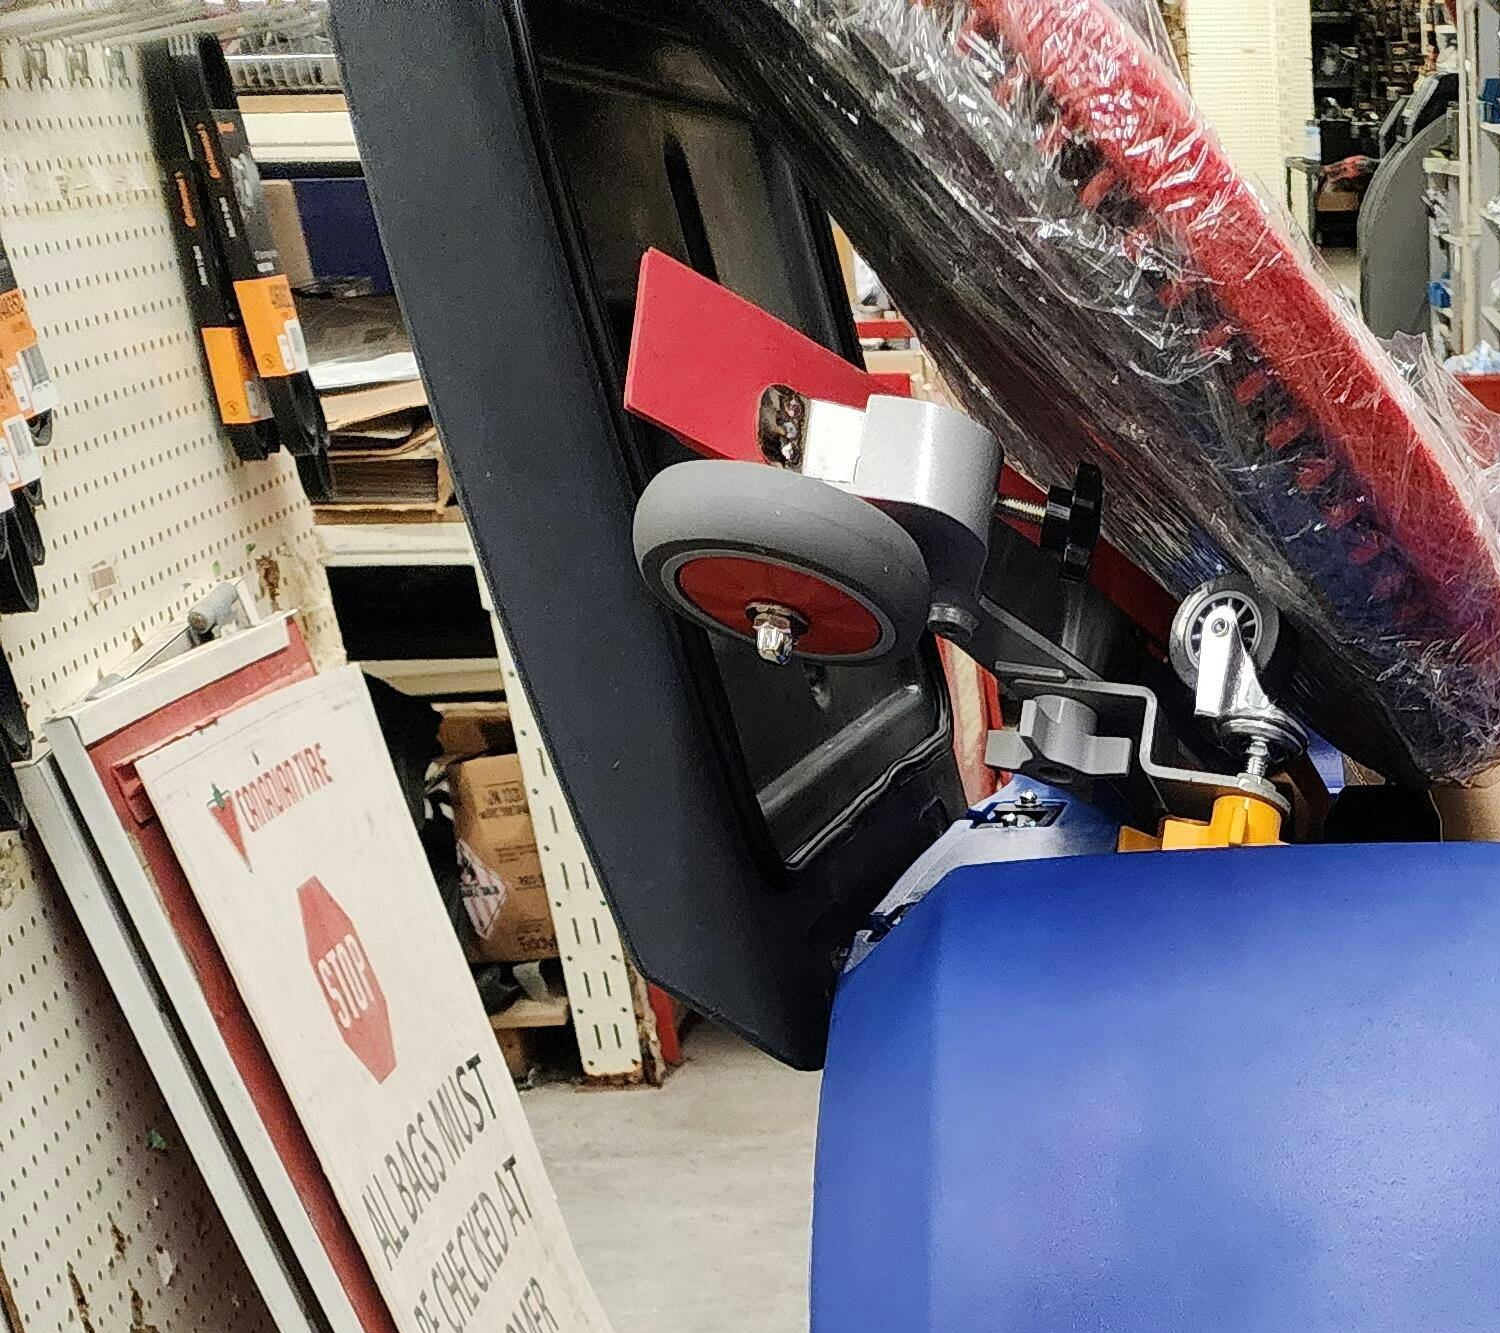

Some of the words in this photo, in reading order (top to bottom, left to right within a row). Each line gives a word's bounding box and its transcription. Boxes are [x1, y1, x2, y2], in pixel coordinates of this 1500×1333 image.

[235, 759, 304, 832] CANADIAN
[292, 742, 332, 796] TIRE
[317, 933, 375, 1029] STOP
[428, 1052, 497, 1166] MUST
[384, 1112, 447, 1225] BAGS
[493, 1154, 533, 1236] AT
[362, 1174, 410, 1272] ALL
